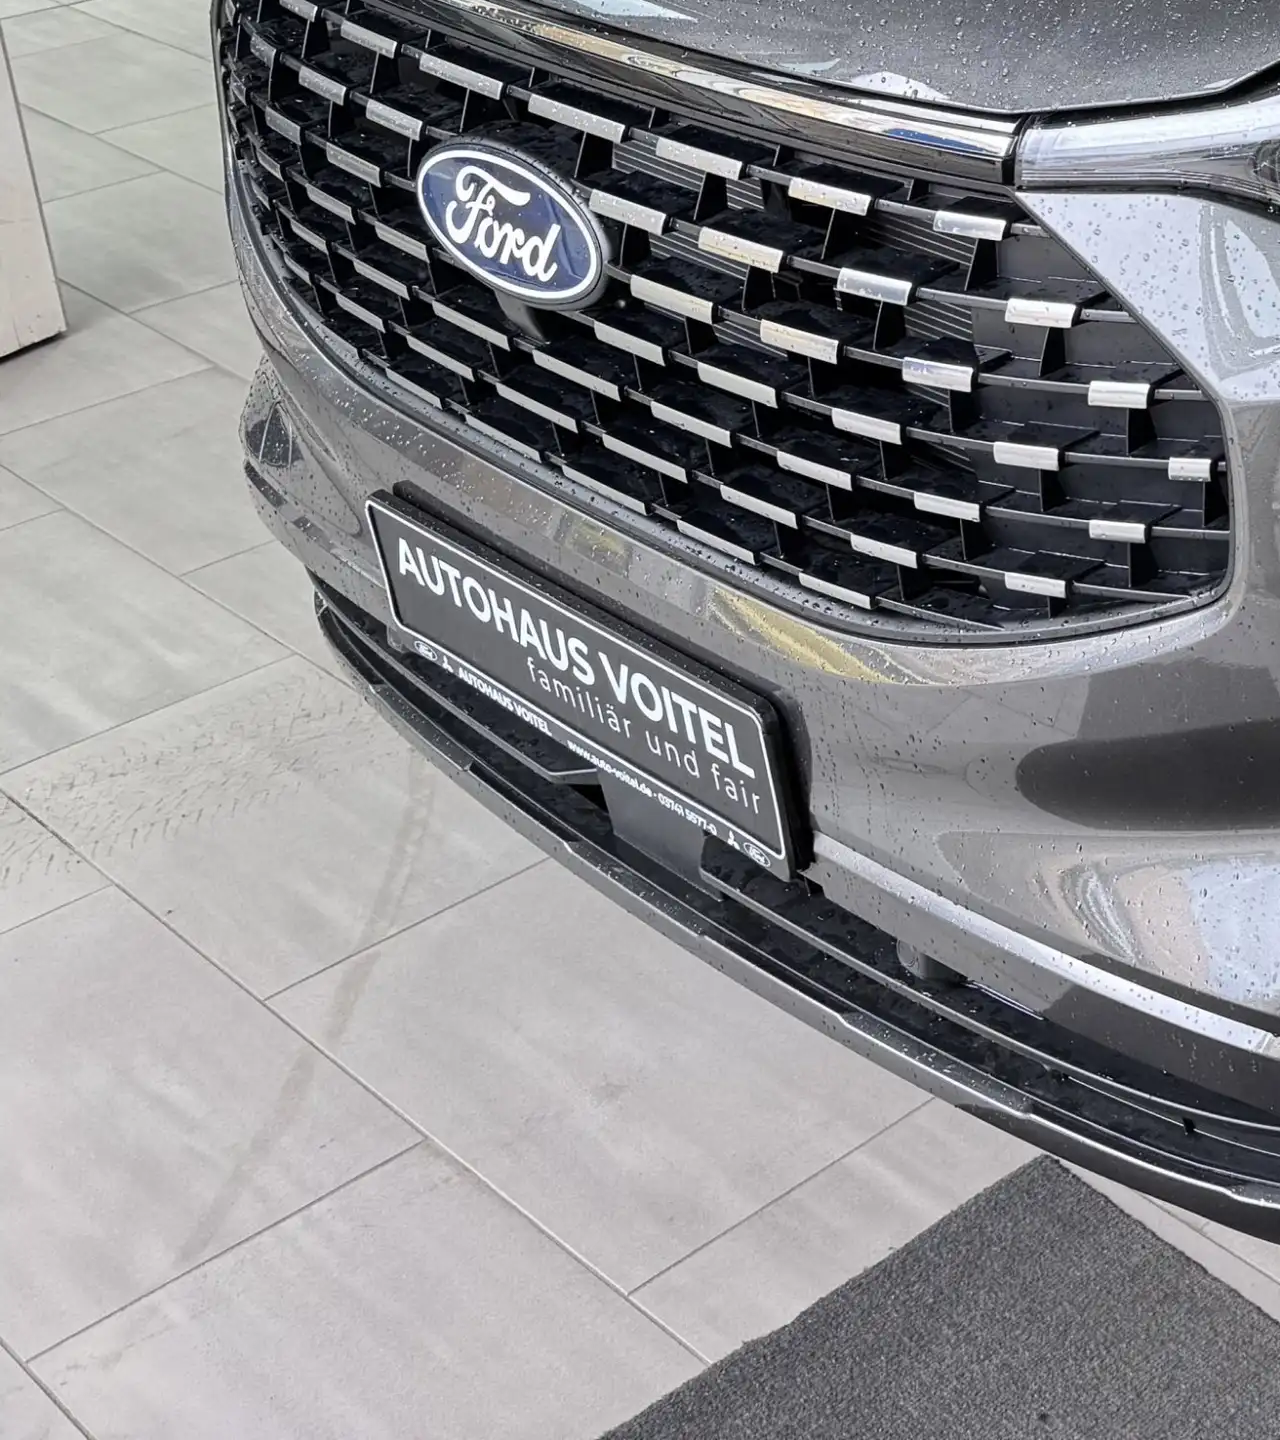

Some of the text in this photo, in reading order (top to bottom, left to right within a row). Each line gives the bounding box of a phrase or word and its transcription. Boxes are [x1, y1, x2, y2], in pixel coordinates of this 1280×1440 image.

[446, 164, 561, 283] Ford
[398, 537, 755, 779] AUTOHAUS VOITEL
[458, 667, 553, 737] AUTOHAUS VOITEL
[527, 655, 761, 814] familiär und fair
